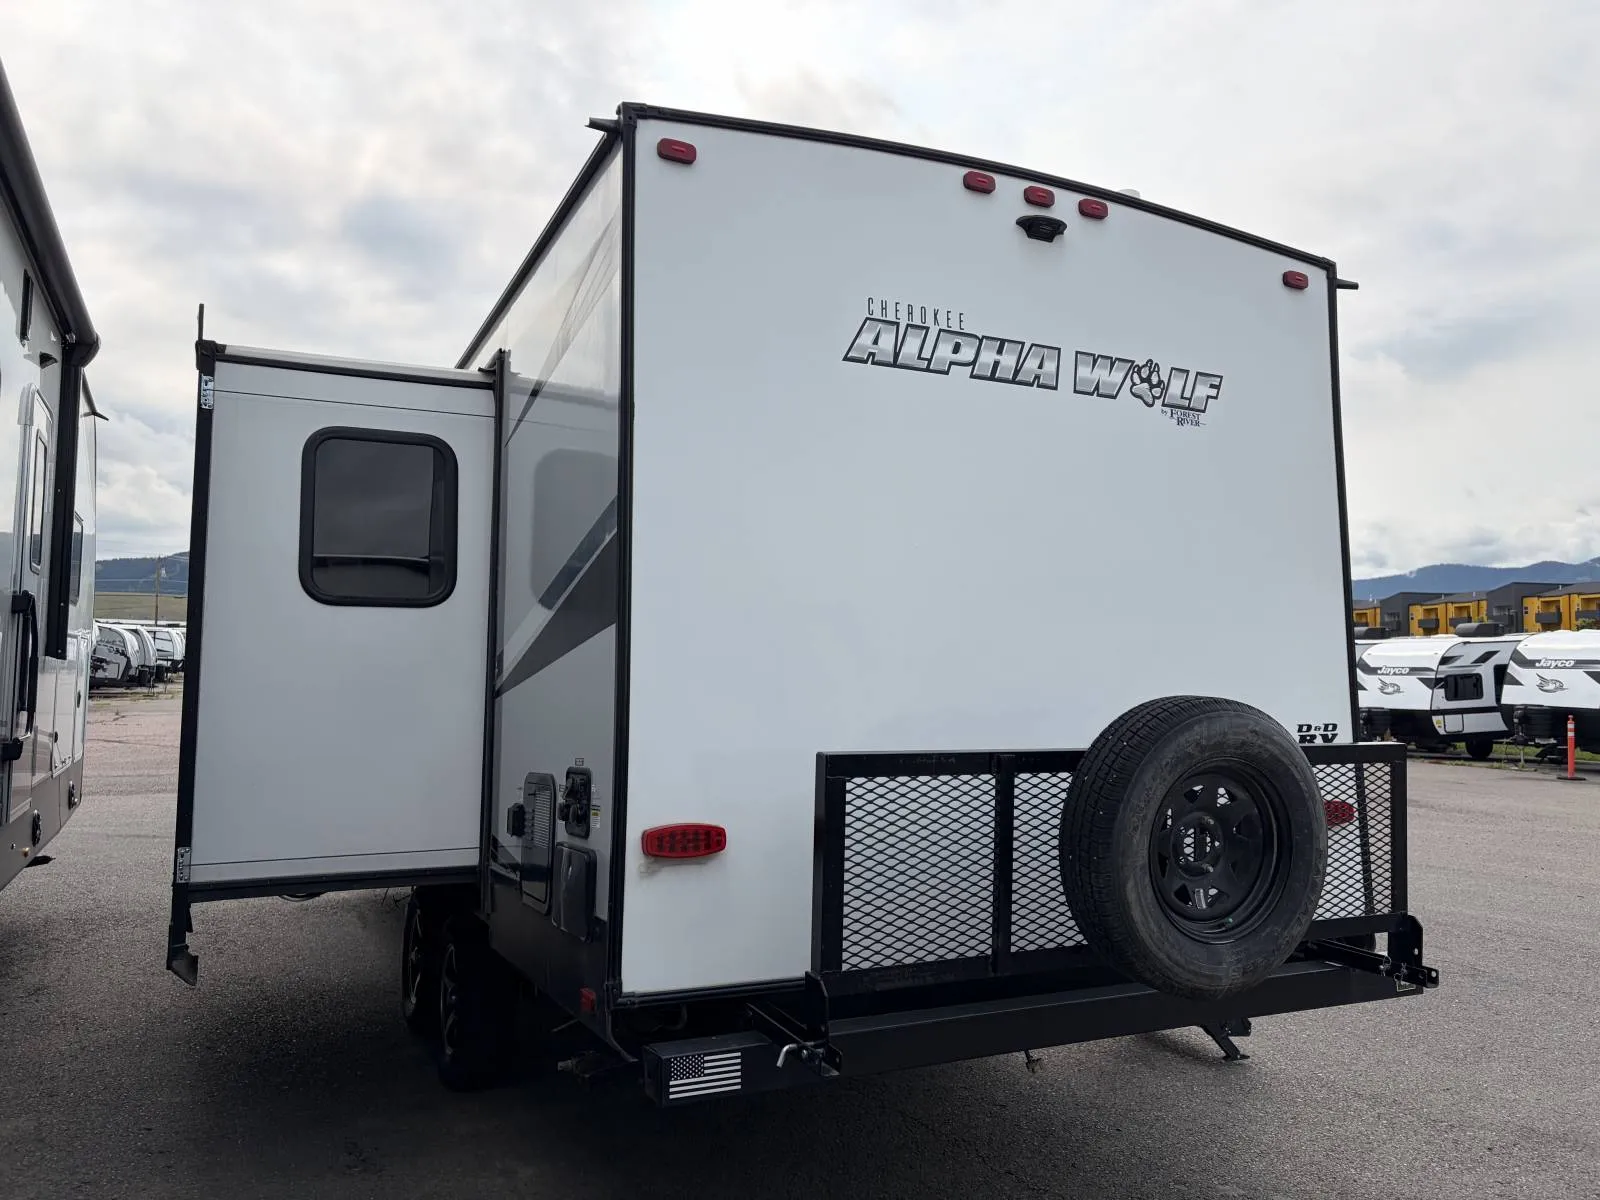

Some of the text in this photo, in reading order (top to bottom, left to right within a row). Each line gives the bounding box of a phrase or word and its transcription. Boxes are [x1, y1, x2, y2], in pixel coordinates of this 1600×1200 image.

[867, 297, 965, 331] CHEROKEE
[842, 317, 1061, 391] ALPHA
[1535, 657, 1575, 669] Jayco
[1377, 665, 1410, 675] Jayco
[1297, 723, 1338, 733] D&D
[1298, 733, 1338, 744] RV
